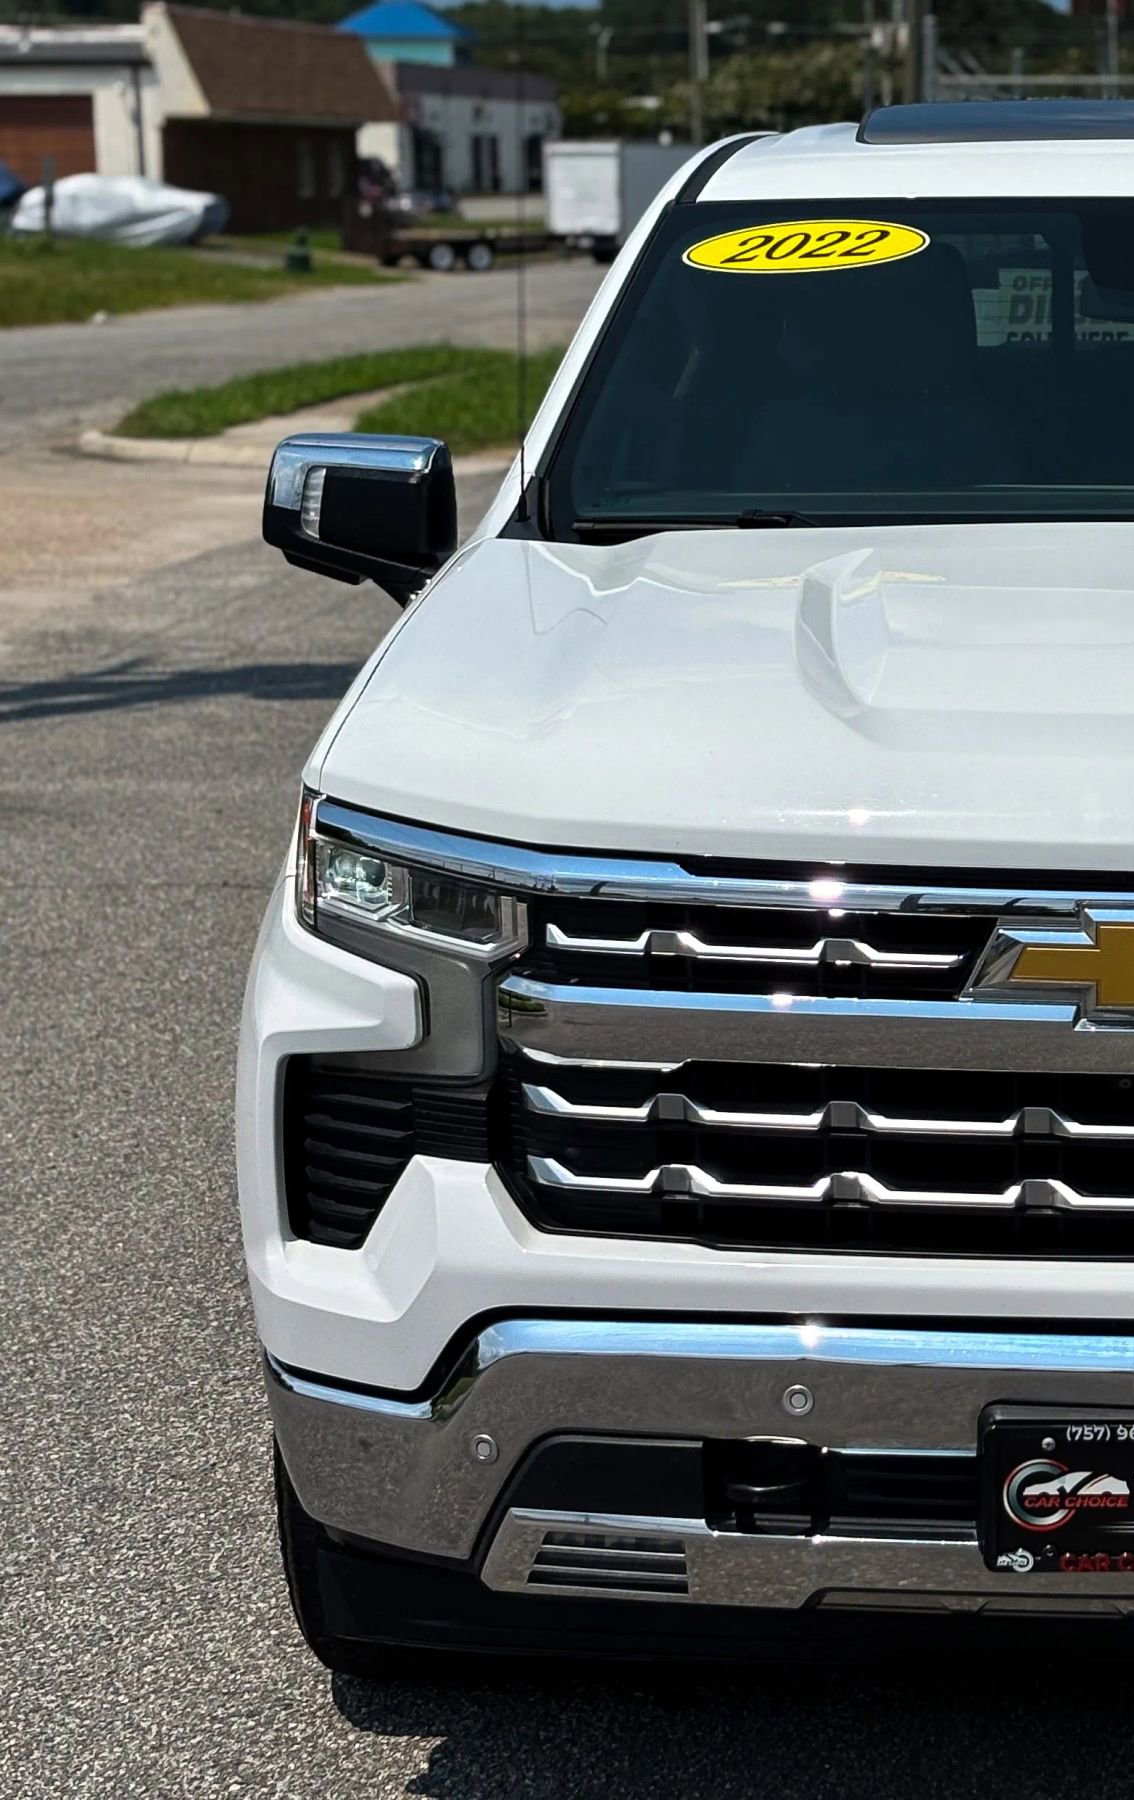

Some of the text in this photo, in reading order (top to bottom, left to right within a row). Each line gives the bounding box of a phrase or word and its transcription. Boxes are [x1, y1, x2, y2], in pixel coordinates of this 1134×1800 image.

[720, 230, 890, 264] 2022
[1066, 1425, 1111, 1442] (757)
[1024, 1496, 1129, 1508] CAR CHOICE
[1059, 1552, 1111, 1571] CAR
